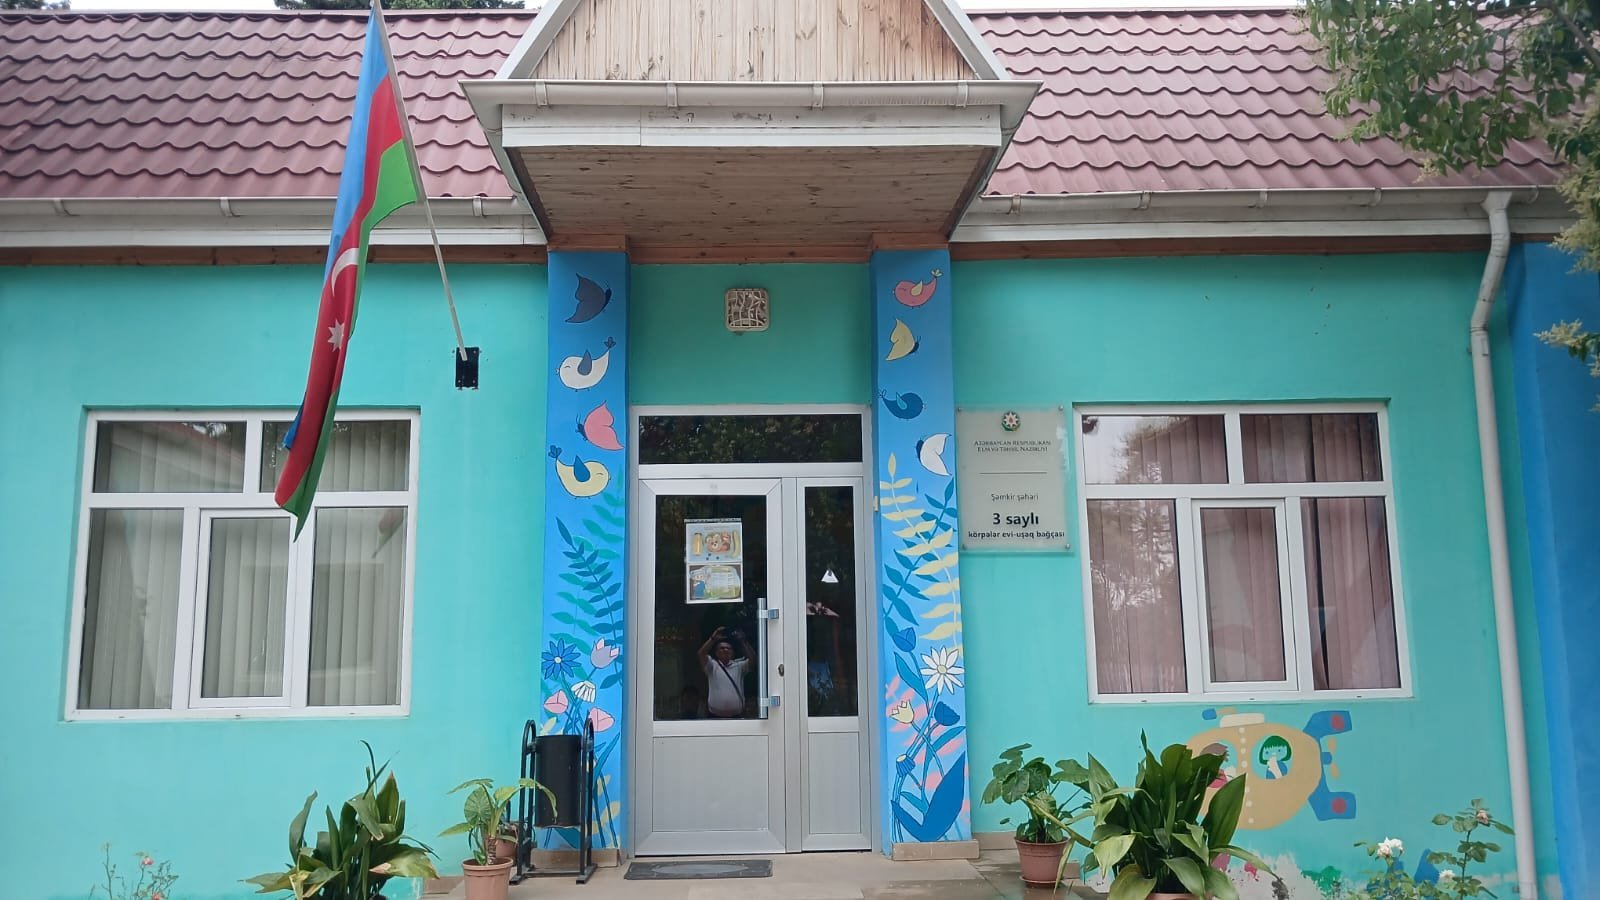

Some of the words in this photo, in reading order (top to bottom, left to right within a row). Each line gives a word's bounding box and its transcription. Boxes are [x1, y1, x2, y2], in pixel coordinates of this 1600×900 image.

[991, 493, 1015, 501] Şəmkir
[992, 512, 1001, 525] 3
[1006, 512, 1039, 528] saylı
[968, 531, 1001, 539] körpələr
[1036, 531, 1065, 539] bağçası
